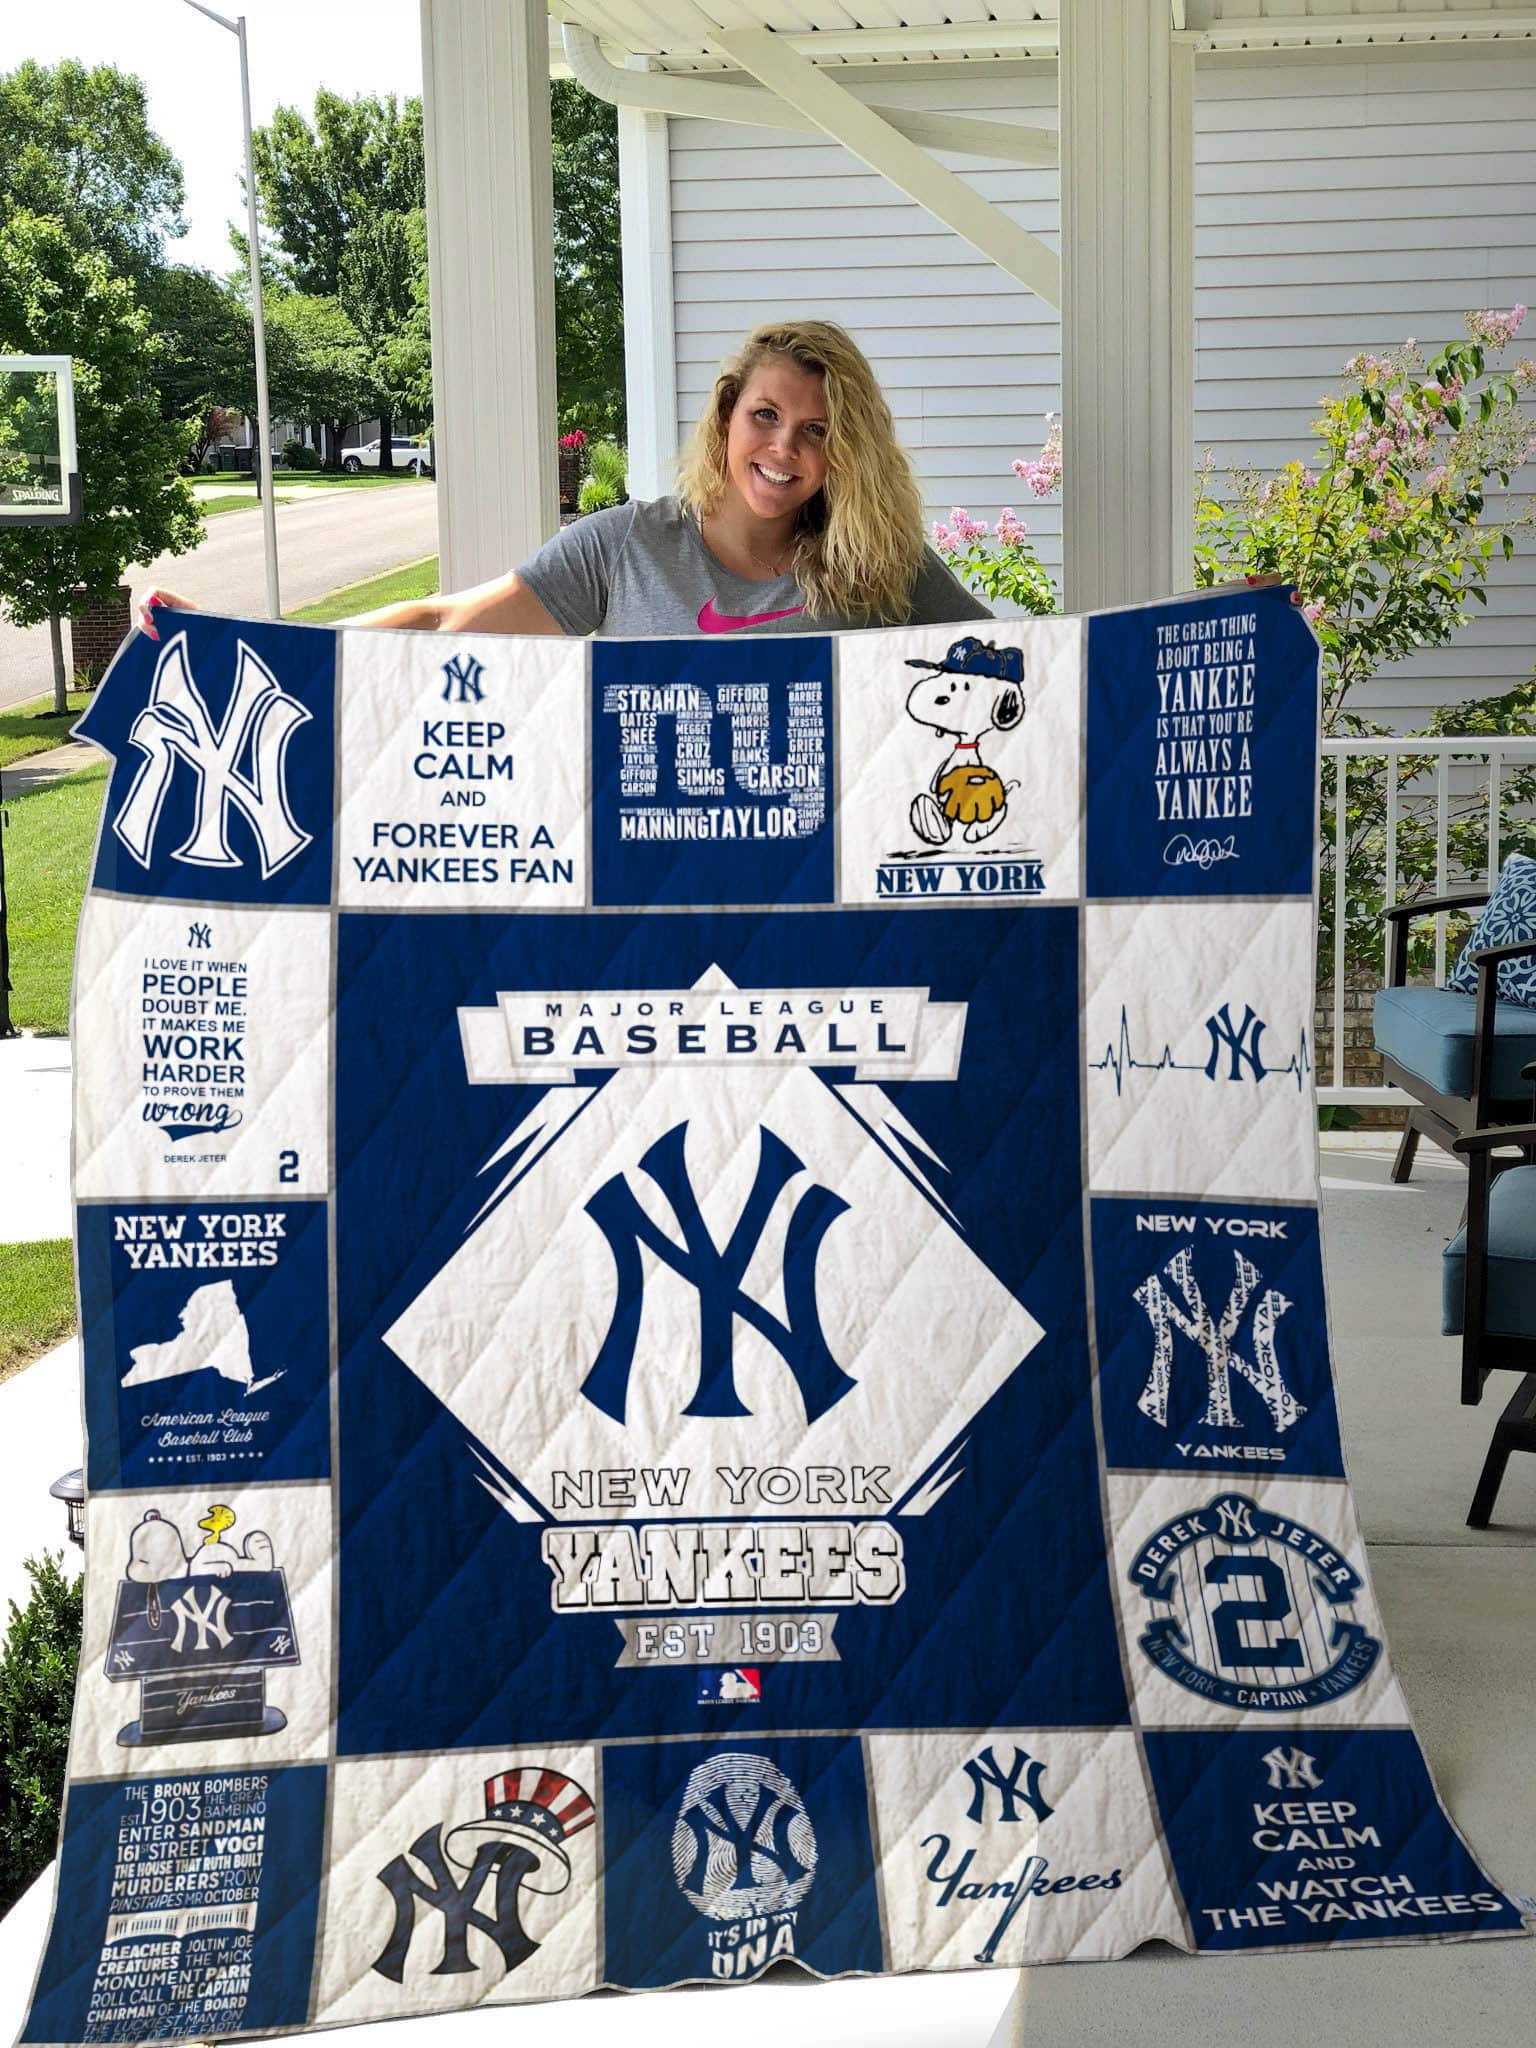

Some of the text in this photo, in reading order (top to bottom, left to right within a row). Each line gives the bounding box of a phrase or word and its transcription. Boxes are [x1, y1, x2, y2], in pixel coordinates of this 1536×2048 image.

[12, 489, 59, 502] SPALDING
[1157, 613, 1256, 645] THE GREAT THING
[1156, 638, 1256, 671] ABOUT BEING A
[617, 689, 700, 712] STRAHAN
[718, 687, 768, 702] GIFFORD
[1157, 664, 1256, 714] YANKEE
[620, 712, 657, 727] OATES
[731, 716, 769, 728] MORRIS
[1156, 710, 1253, 739] IS THAT YOU'RE
[423, 721, 505, 747] KEEP
[621, 728, 656, 744] SNEE
[733, 730, 768, 748] HUFF
[789, 738, 823, 753] GRIER
[622, 754, 655, 765] TAYLOR
[677, 743, 711, 759] CRUZ
[787, 752, 825, 765] MARTIN
[1155, 737, 1252, 776] ALWAYS A
[414, 752, 514, 781] CALM
[620, 769, 657, 780] GIFFORD
[677, 768, 725, 786] SIMMS
[747, 765, 820, 789] CARSON
[440, 791, 486, 807] AND
[1155, 775, 1252, 820] YANKEE
[373, 823, 555, 849] FOREVER A
[620, 815, 708, 839] MANNING
[707, 807, 796, 838] TAYLOR
[353, 857, 574, 884] YANKEES FAN
[876, 863, 1046, 893] NEW YORK
[144, 958, 247, 973] I LOVE IT WHEN
[143, 974, 247, 997] PEOPLE
[142, 999, 246, 1016] DOUBT ME.
[545, 999, 884, 1018] MAJOR LEAGUE
[142, 1018, 246, 1033] IT MAKES ME
[143, 1034, 245, 1061] WORK
[523, 1022, 907, 1057] BASEBALL
[143, 1063, 245, 1083] HARDER
[143, 1086, 244, 1097] TO PROVE THEM
[142, 1102, 242, 1132] wrong
[164, 1154, 227, 1163] DEREK JETER
[279, 1150, 299, 1183] 2
[114, 1213, 287, 1241] NEW YORK
[1136, 1214, 1289, 1240] NEW YORK
[123, 1240, 278, 1269] YANKEES
[140, 1407, 270, 1428] American League
[157, 1428, 253, 1448] Baseball Club
[1175, 1442, 1287, 1460] YANKEES
[552, 1466, 893, 1508] NEW YORK
[1138, 1515, 1207, 1580] DEREK
[1270, 1521, 1350, 1585] JETER
[543, 1522, 904, 1611] YANKEES
[1204, 1555, 1305, 1667] 2
[636, 1620, 824, 1660] EST 1903
[1148, 1638, 1374, 1707] NEW YORK CAPTAIN YANKEES
[176, 1685, 236, 1715] Yankees
[125, 1776, 269, 1800] THE BRONX BOMBERS
[205, 1790, 267, 1805] THE GREAT
[141, 1796, 202, 1825] 1903
[203, 1801, 267, 1819] BAMBINO
[1253, 1801, 1358, 1826] KEEP
[118, 1817, 266, 1844] ENTER SANDMAN
[1252, 1826, 1382, 1852] CALM
[149, 1838, 209, 1861] STREET
[214, 1834, 264, 1854] YOGI
[114, 1852, 263, 1880] THE HOUSE THAT RUTH BUILT
[1297, 1856, 1356, 1872] AND
[111, 1868, 263, 1897] MURDERERS' ROW
[920, 1834, 1122, 1930] Yankees
[1256, 1874, 1417, 1901] WATCH
[109, 1893, 182, 1912] PINSTRIPES
[204, 1887, 259, 1904] OCTOBER
[1202, 1892, 1504, 1931] THE YANKEES
[708, 1924, 741, 1948] IT'S
[745, 1917, 767, 1938] IN
[101, 1934, 254, 1962] BLEACHER JOLTIN' JOE
[712, 1923, 794, 1979] DNA
[97, 1949, 254, 1976] CREATURES THE MICK
[92, 1963, 253, 1993] MONUMENT PARK
[90, 1977, 250, 2009] ROLL CALL THE CAPTAIN
[86, 1995, 248, 2024] CHAIRMAN OF THE BOARD
